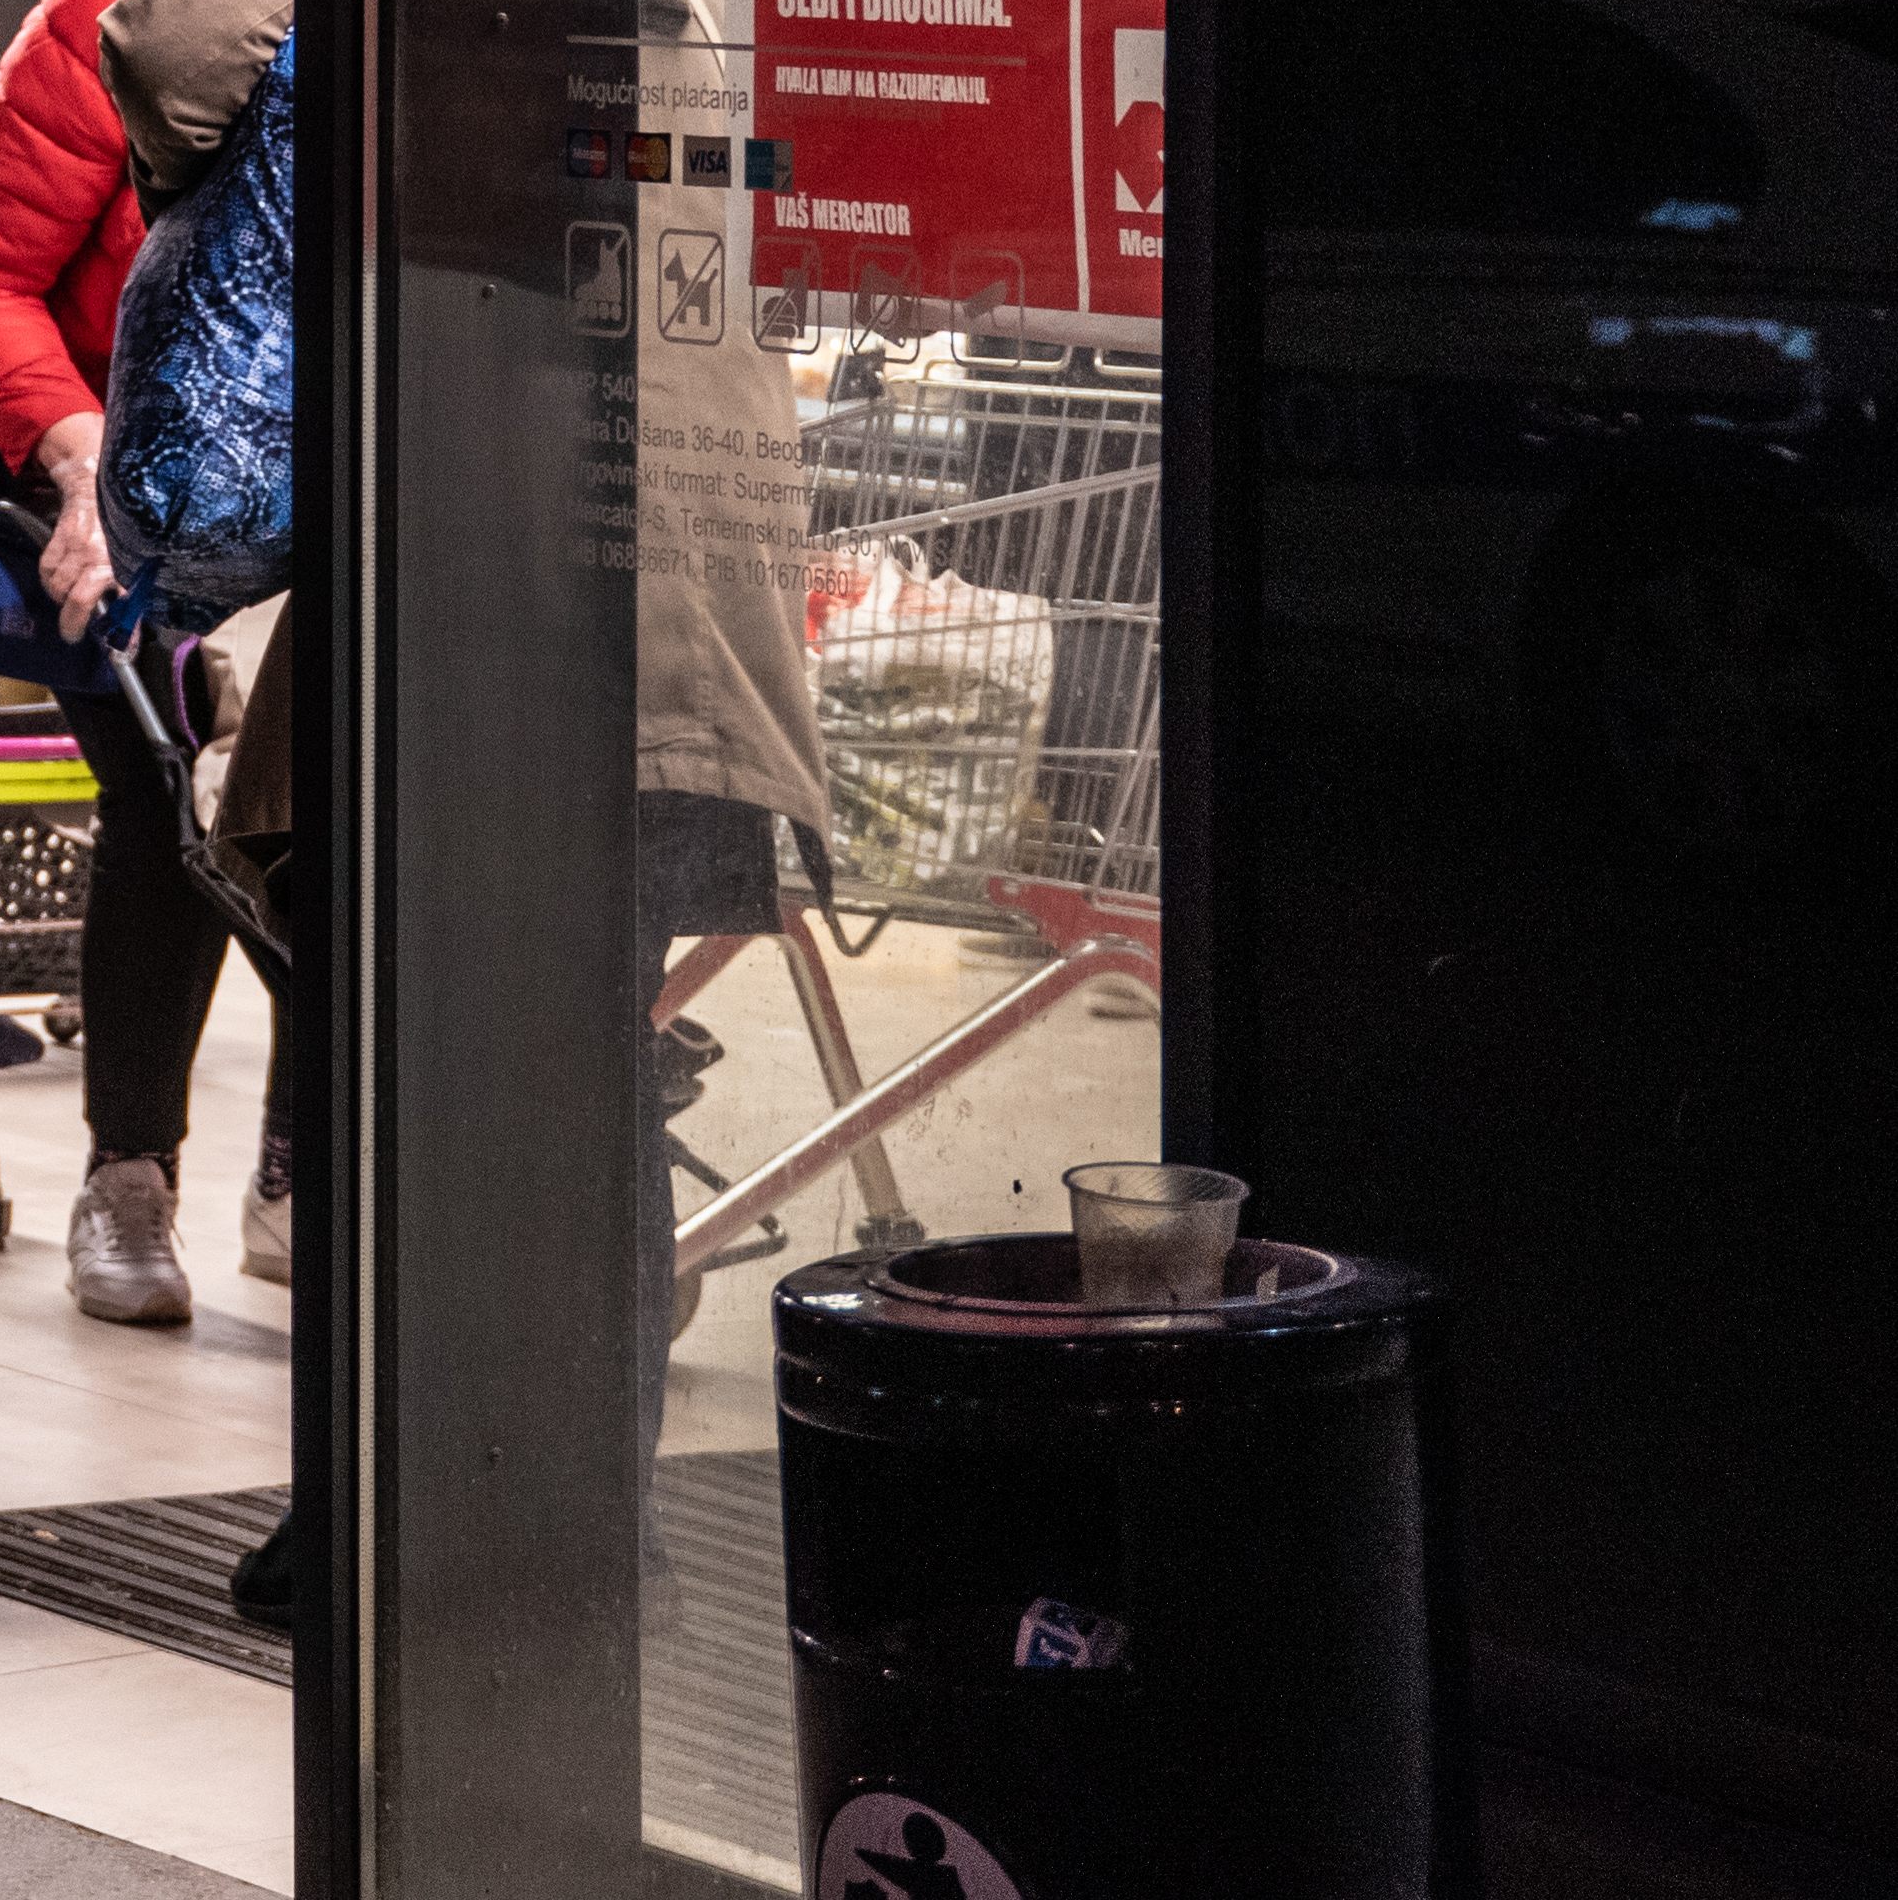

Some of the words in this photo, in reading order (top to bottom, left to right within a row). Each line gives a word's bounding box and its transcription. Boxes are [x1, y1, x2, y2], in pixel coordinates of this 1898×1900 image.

[566, 73, 667, 111] Mogućnost
[671, 81, 750, 119] plaćanja
[688, 150, 728, 174] VISA
[774, 191, 810, 230] VAŠ
[811, 196, 911, 238] MERCATOR
[703, 551, 737, 582] PIB
